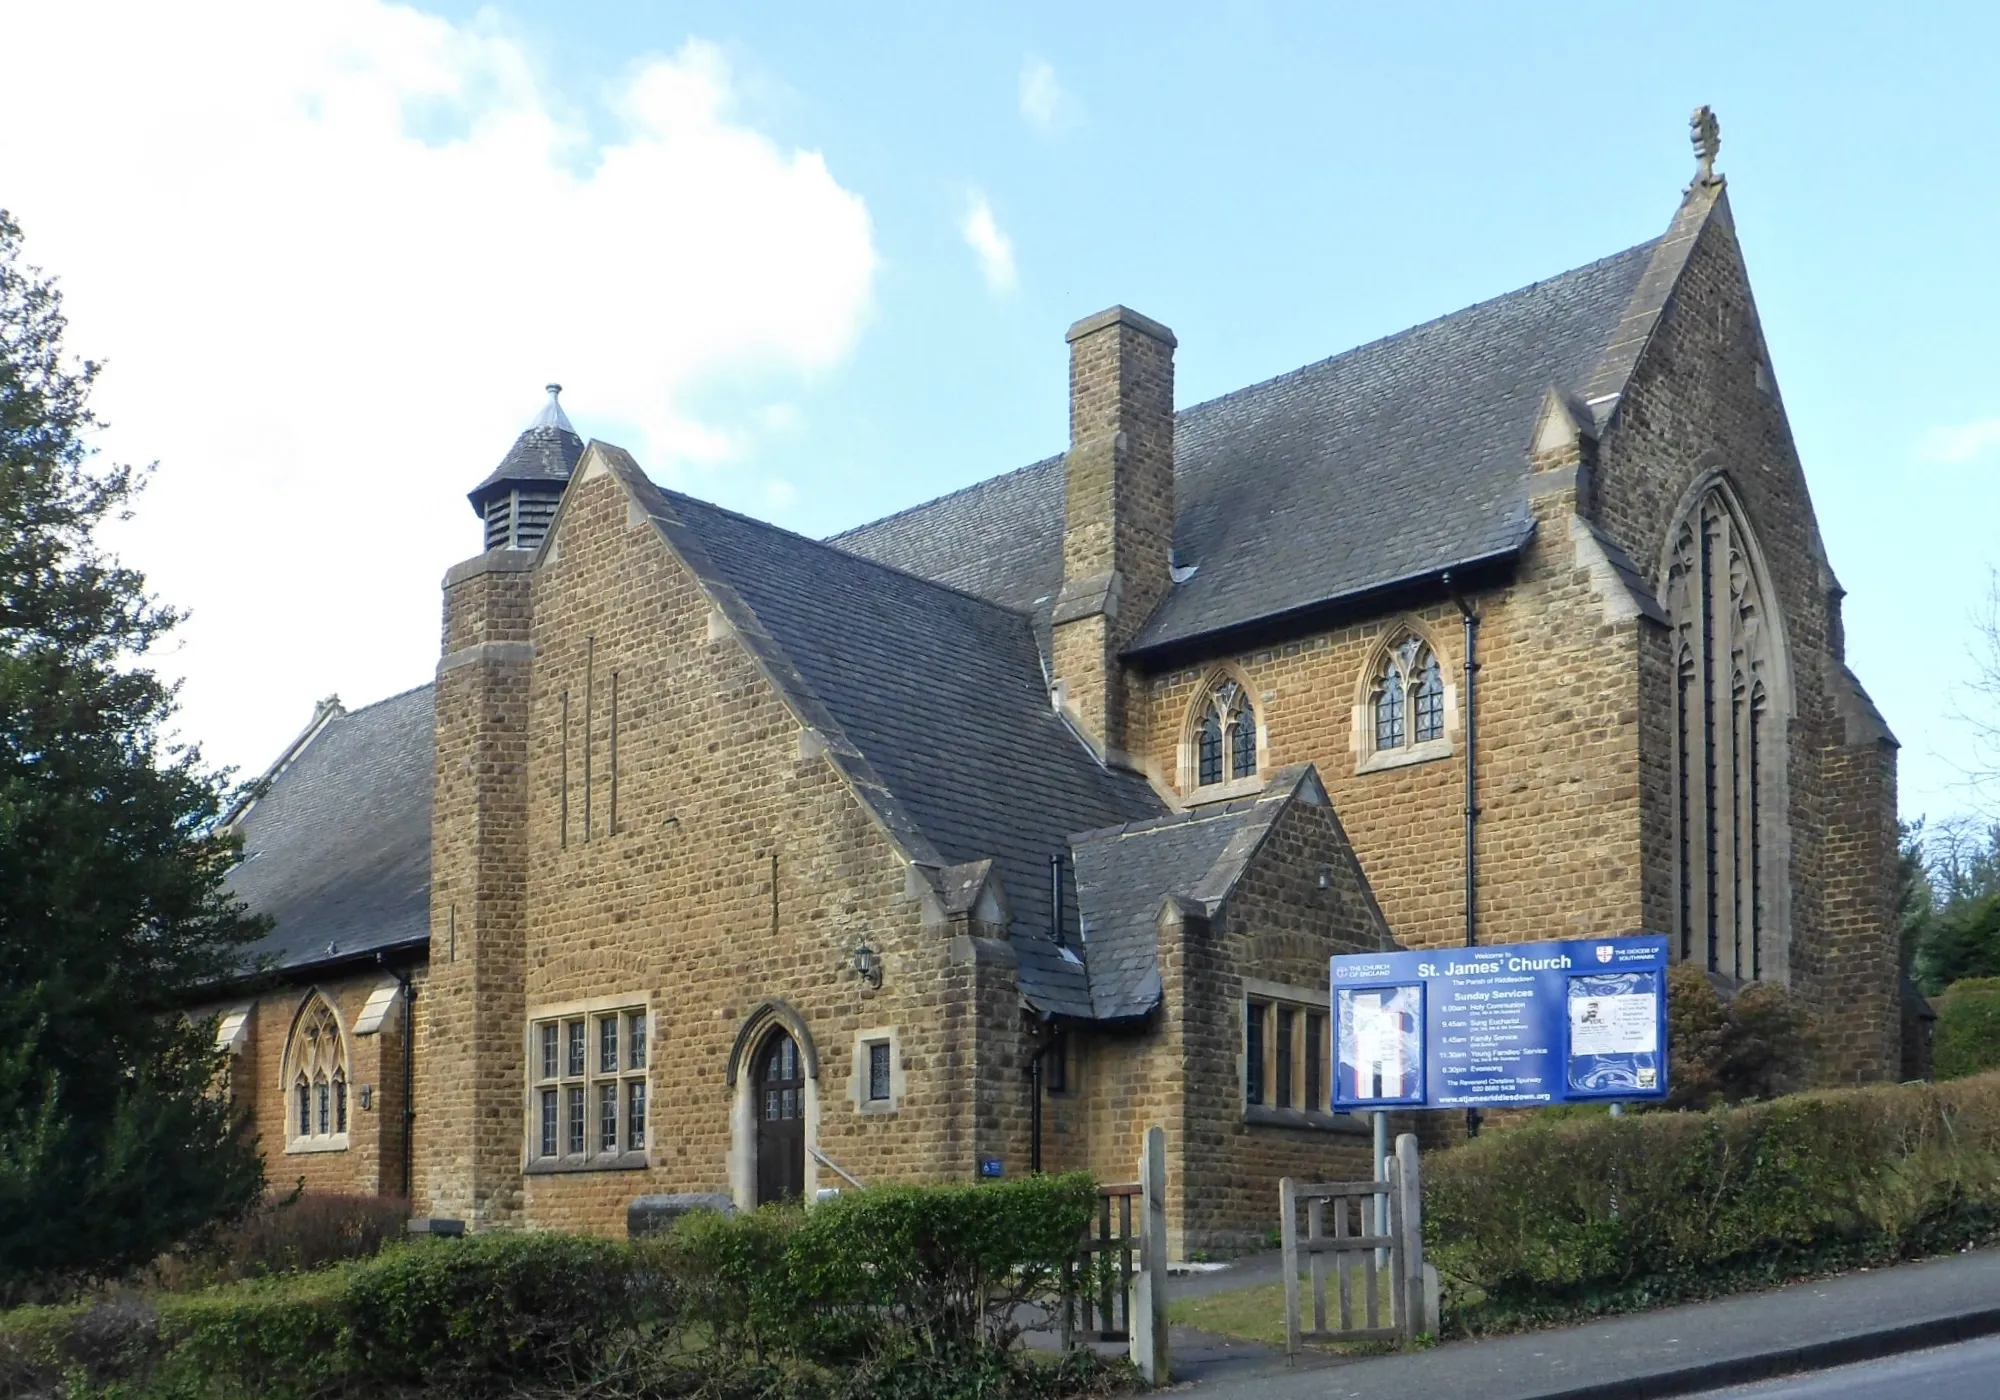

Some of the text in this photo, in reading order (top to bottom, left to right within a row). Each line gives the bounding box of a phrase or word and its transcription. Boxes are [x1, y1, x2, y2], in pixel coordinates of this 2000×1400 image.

[1474, 952, 1503, 960] Welcome
[1418, 964, 1440, 977] St.
[1509, 955, 1572, 972] Church
[1454, 990, 1533, 1001] Sunday Services
[1439, 1093, 1550, 1103] www.stjamesriddlesdown.org
